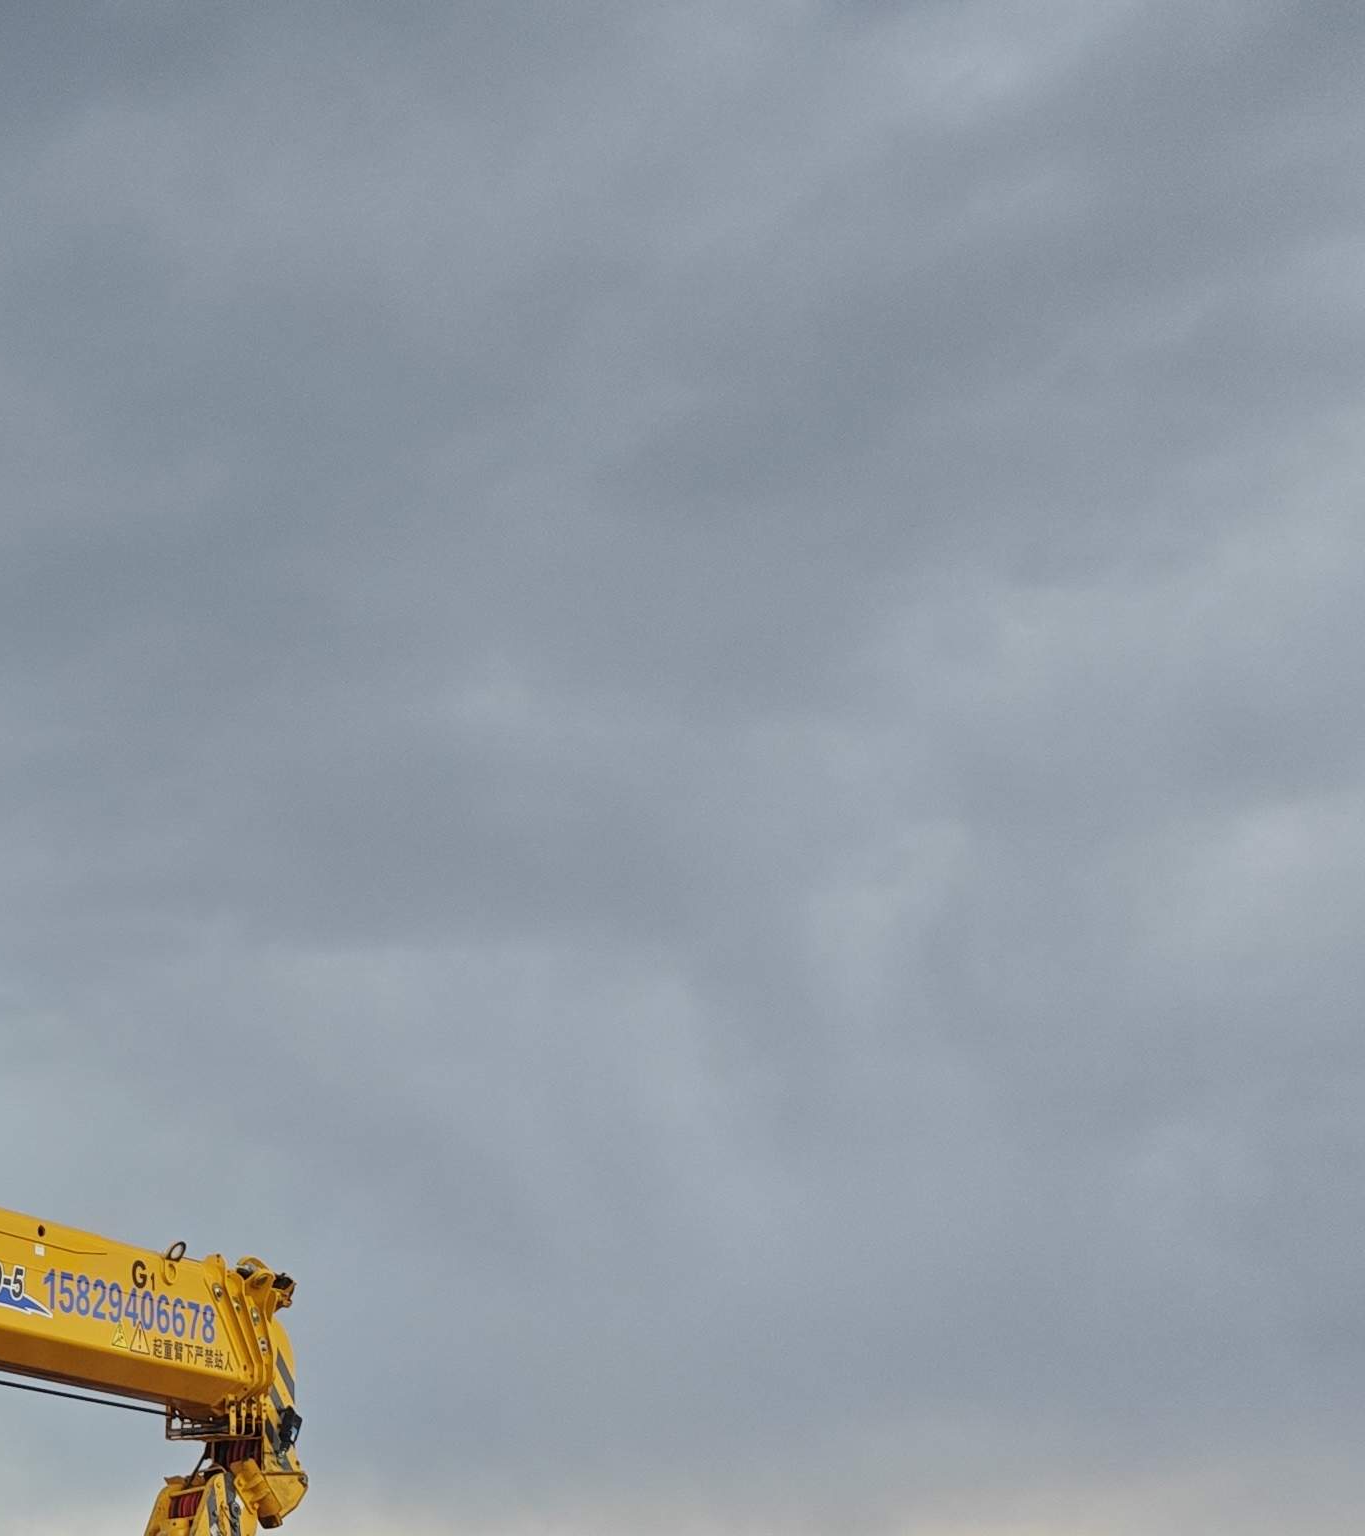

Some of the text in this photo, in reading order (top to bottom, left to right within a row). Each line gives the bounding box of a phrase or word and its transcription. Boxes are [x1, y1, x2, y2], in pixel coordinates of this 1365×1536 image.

[43, 1268, 216, 1344] 15829406678
[153, 1336, 234, 1372] 起重臂下严禁站人
